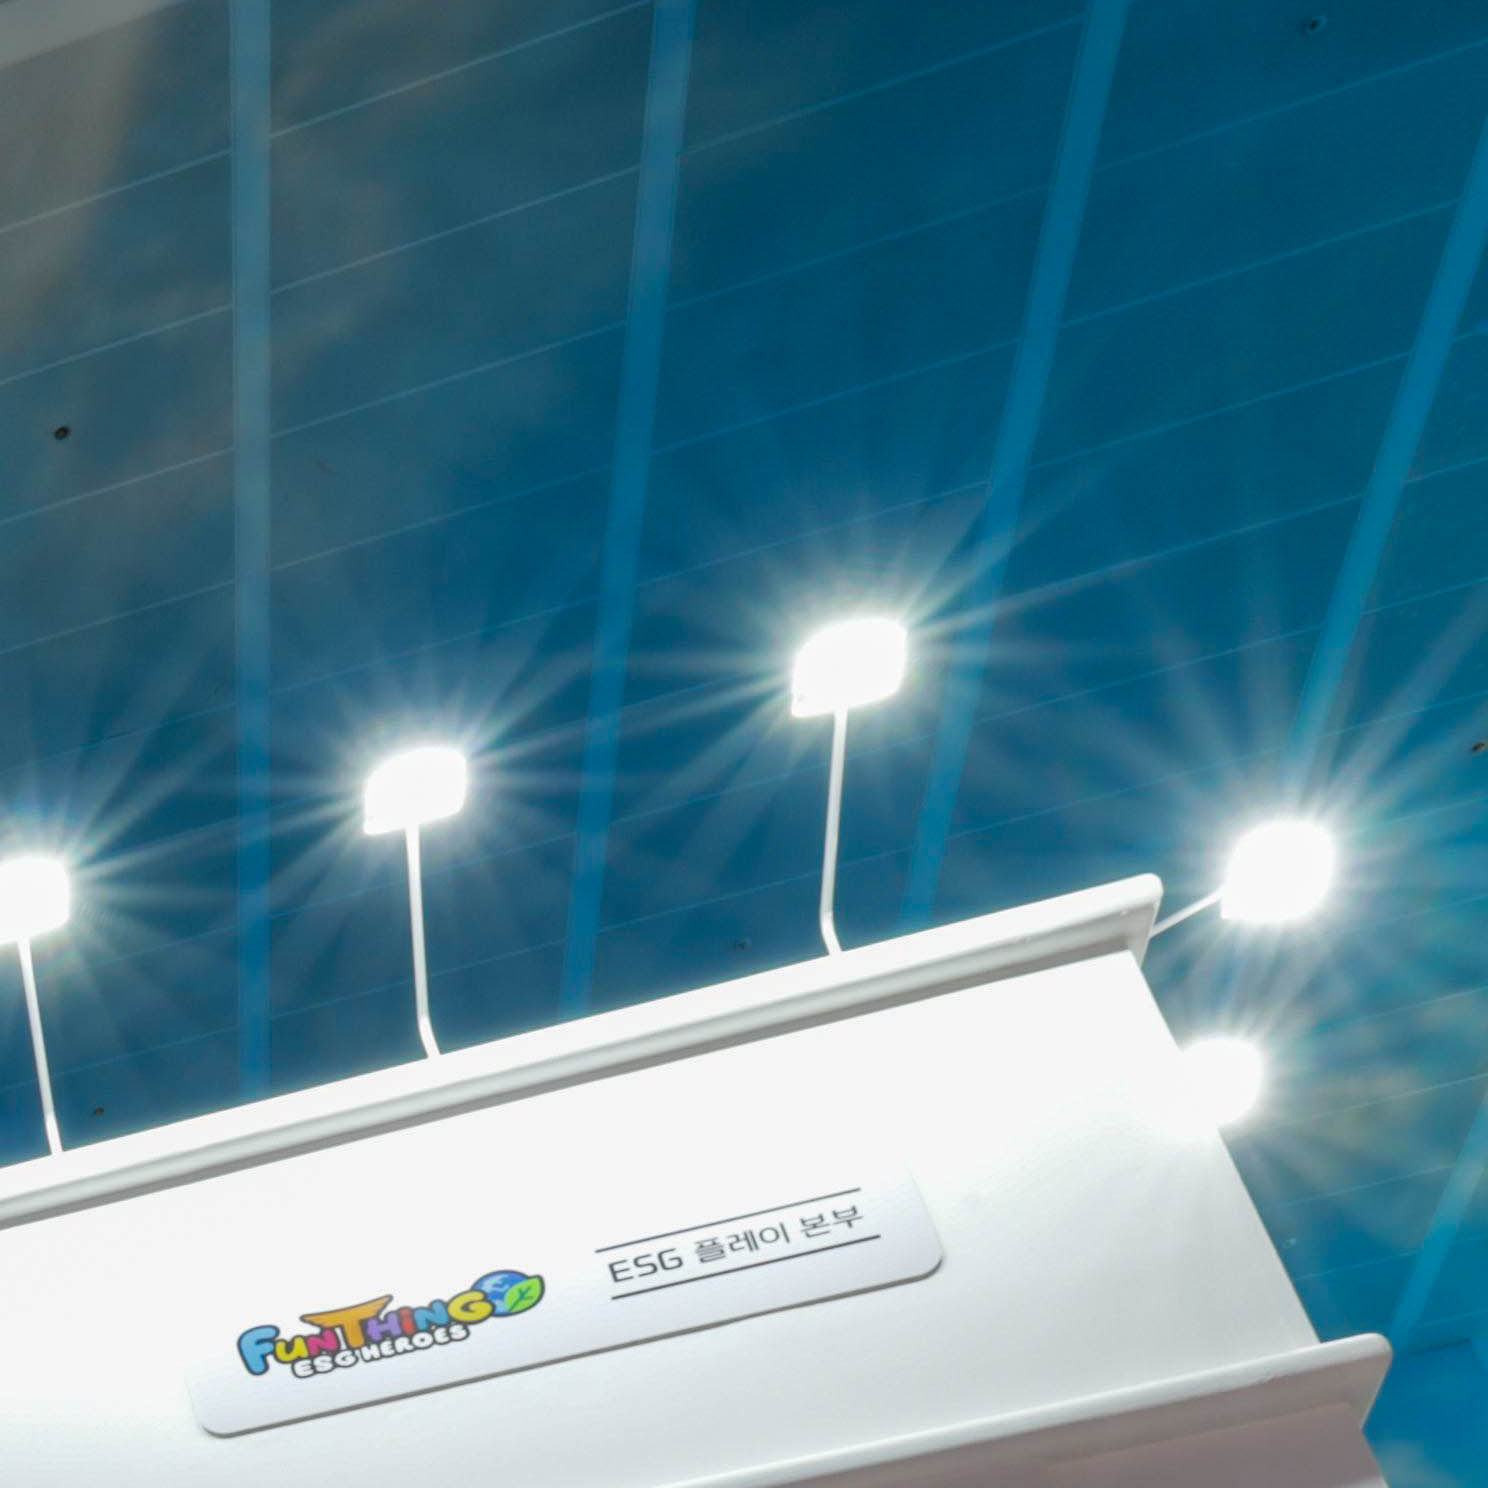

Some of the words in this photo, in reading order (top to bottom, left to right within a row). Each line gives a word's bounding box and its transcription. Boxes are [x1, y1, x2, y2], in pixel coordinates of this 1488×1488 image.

[608, 1249, 684, 1284] ESG
[693, 1219, 791, 1265] 플레이
[799, 1203, 866, 1239] 본부
[292, 1349, 359, 1378] ESG
[358, 1324, 470, 1363] HEROES
